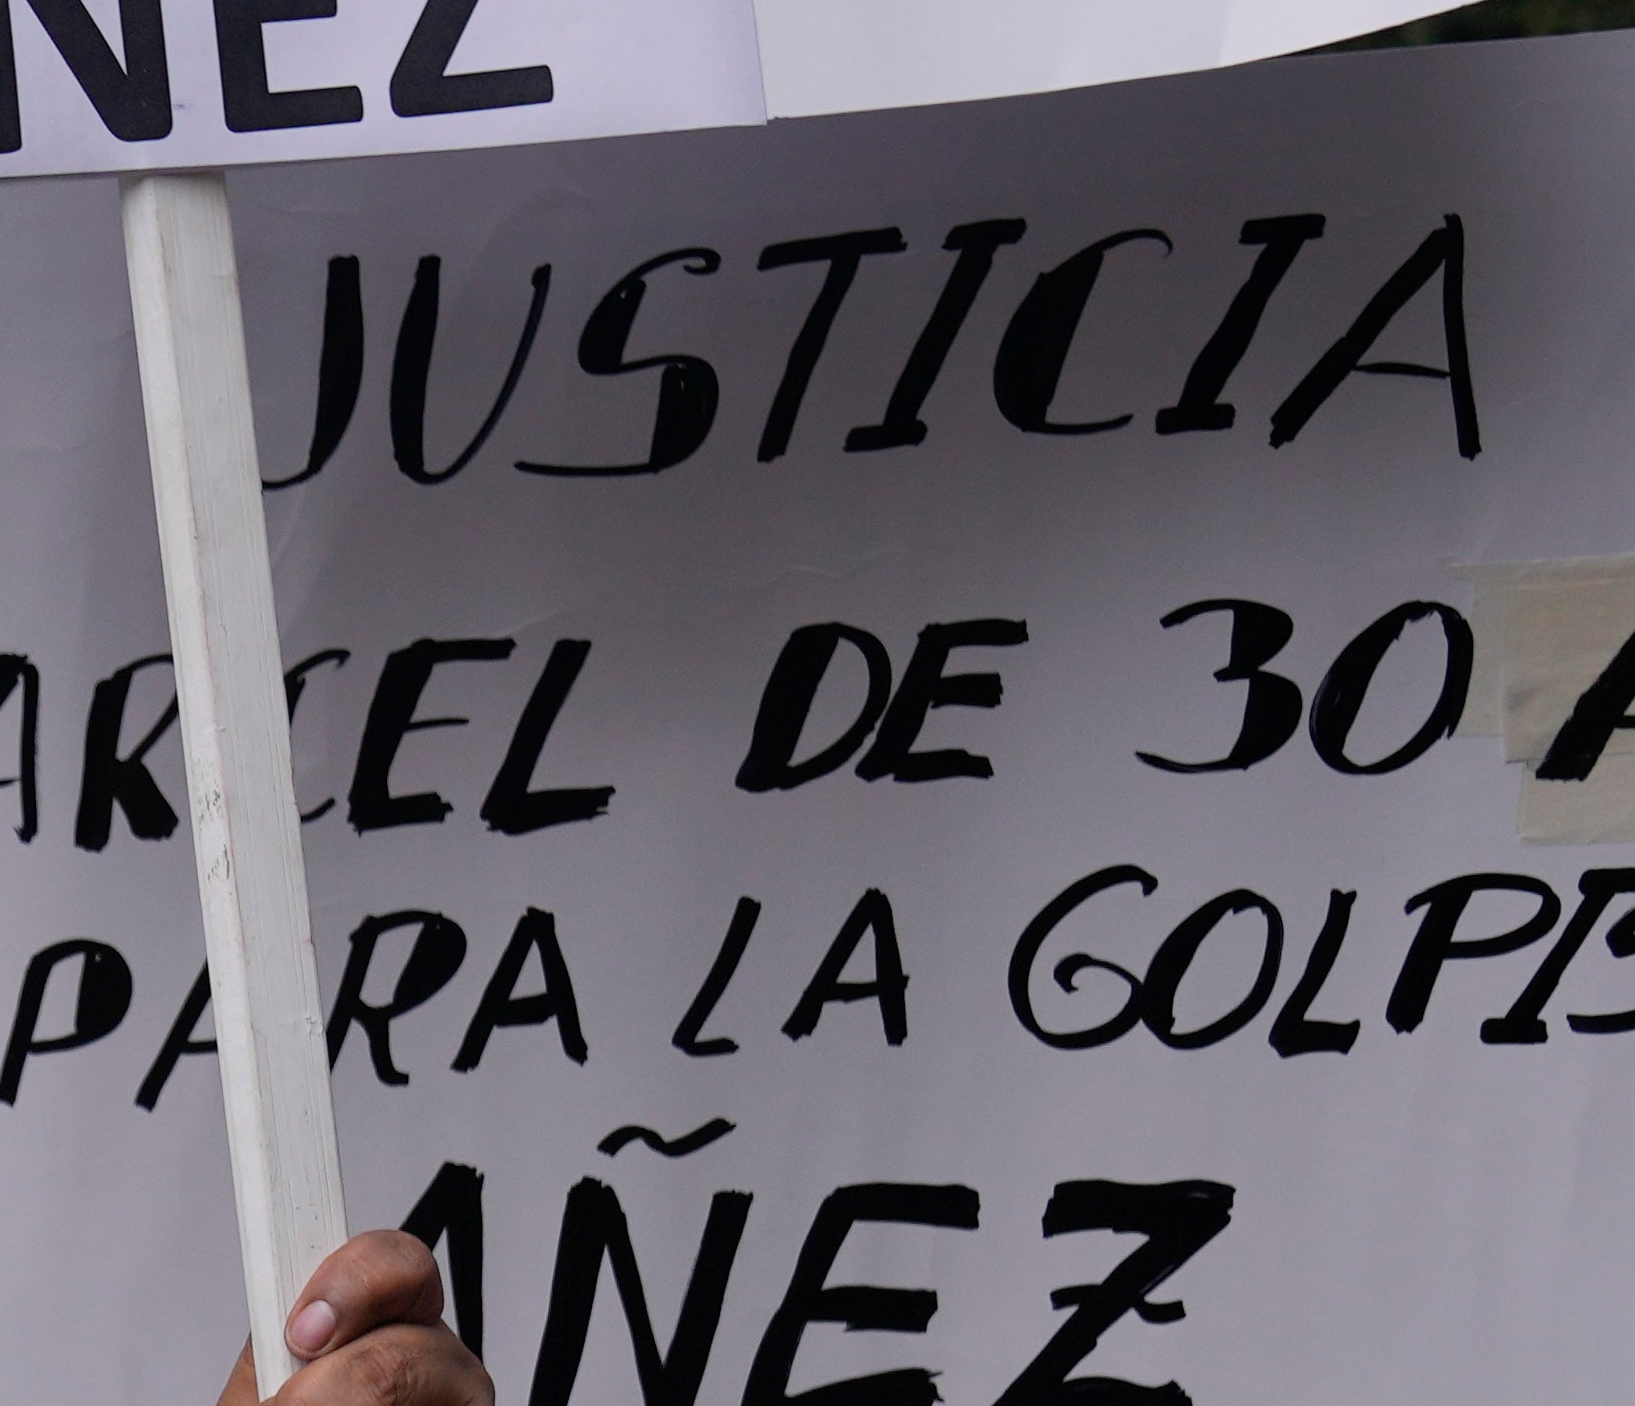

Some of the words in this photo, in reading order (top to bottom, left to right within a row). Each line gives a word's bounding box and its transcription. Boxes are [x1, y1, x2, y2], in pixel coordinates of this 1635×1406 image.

[260, 211, 1484, 492] JUSTICIA
[733, 617, 1031, 794] DE
[1134, 597, 1475, 776] 30
[670, 887, 911, 1060] LA
